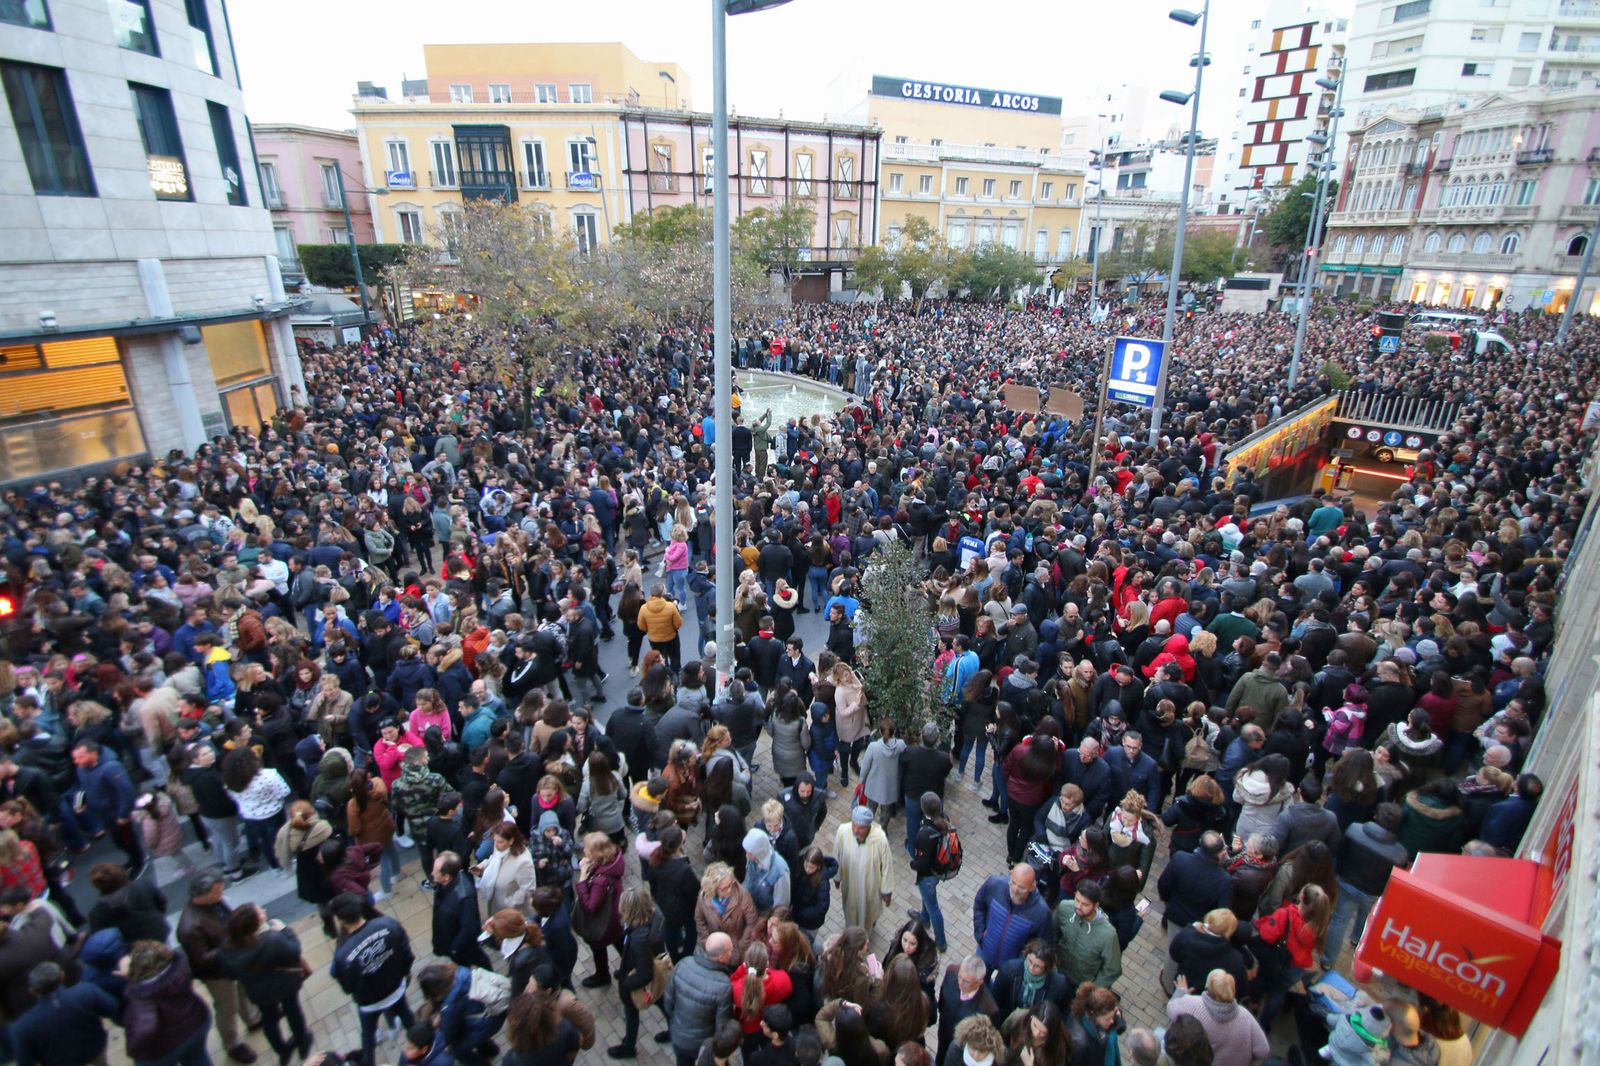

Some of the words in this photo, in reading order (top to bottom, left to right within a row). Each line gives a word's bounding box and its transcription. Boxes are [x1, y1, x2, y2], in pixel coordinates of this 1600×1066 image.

[902, 82, 981, 105] GESTORIA
[991, 93, 1040, 111] ARCOS
[1121, 343, 1150, 380] P
[1380, 940, 1498, 1008] viajes.com
[1381, 917, 1506, 998] Halcon
